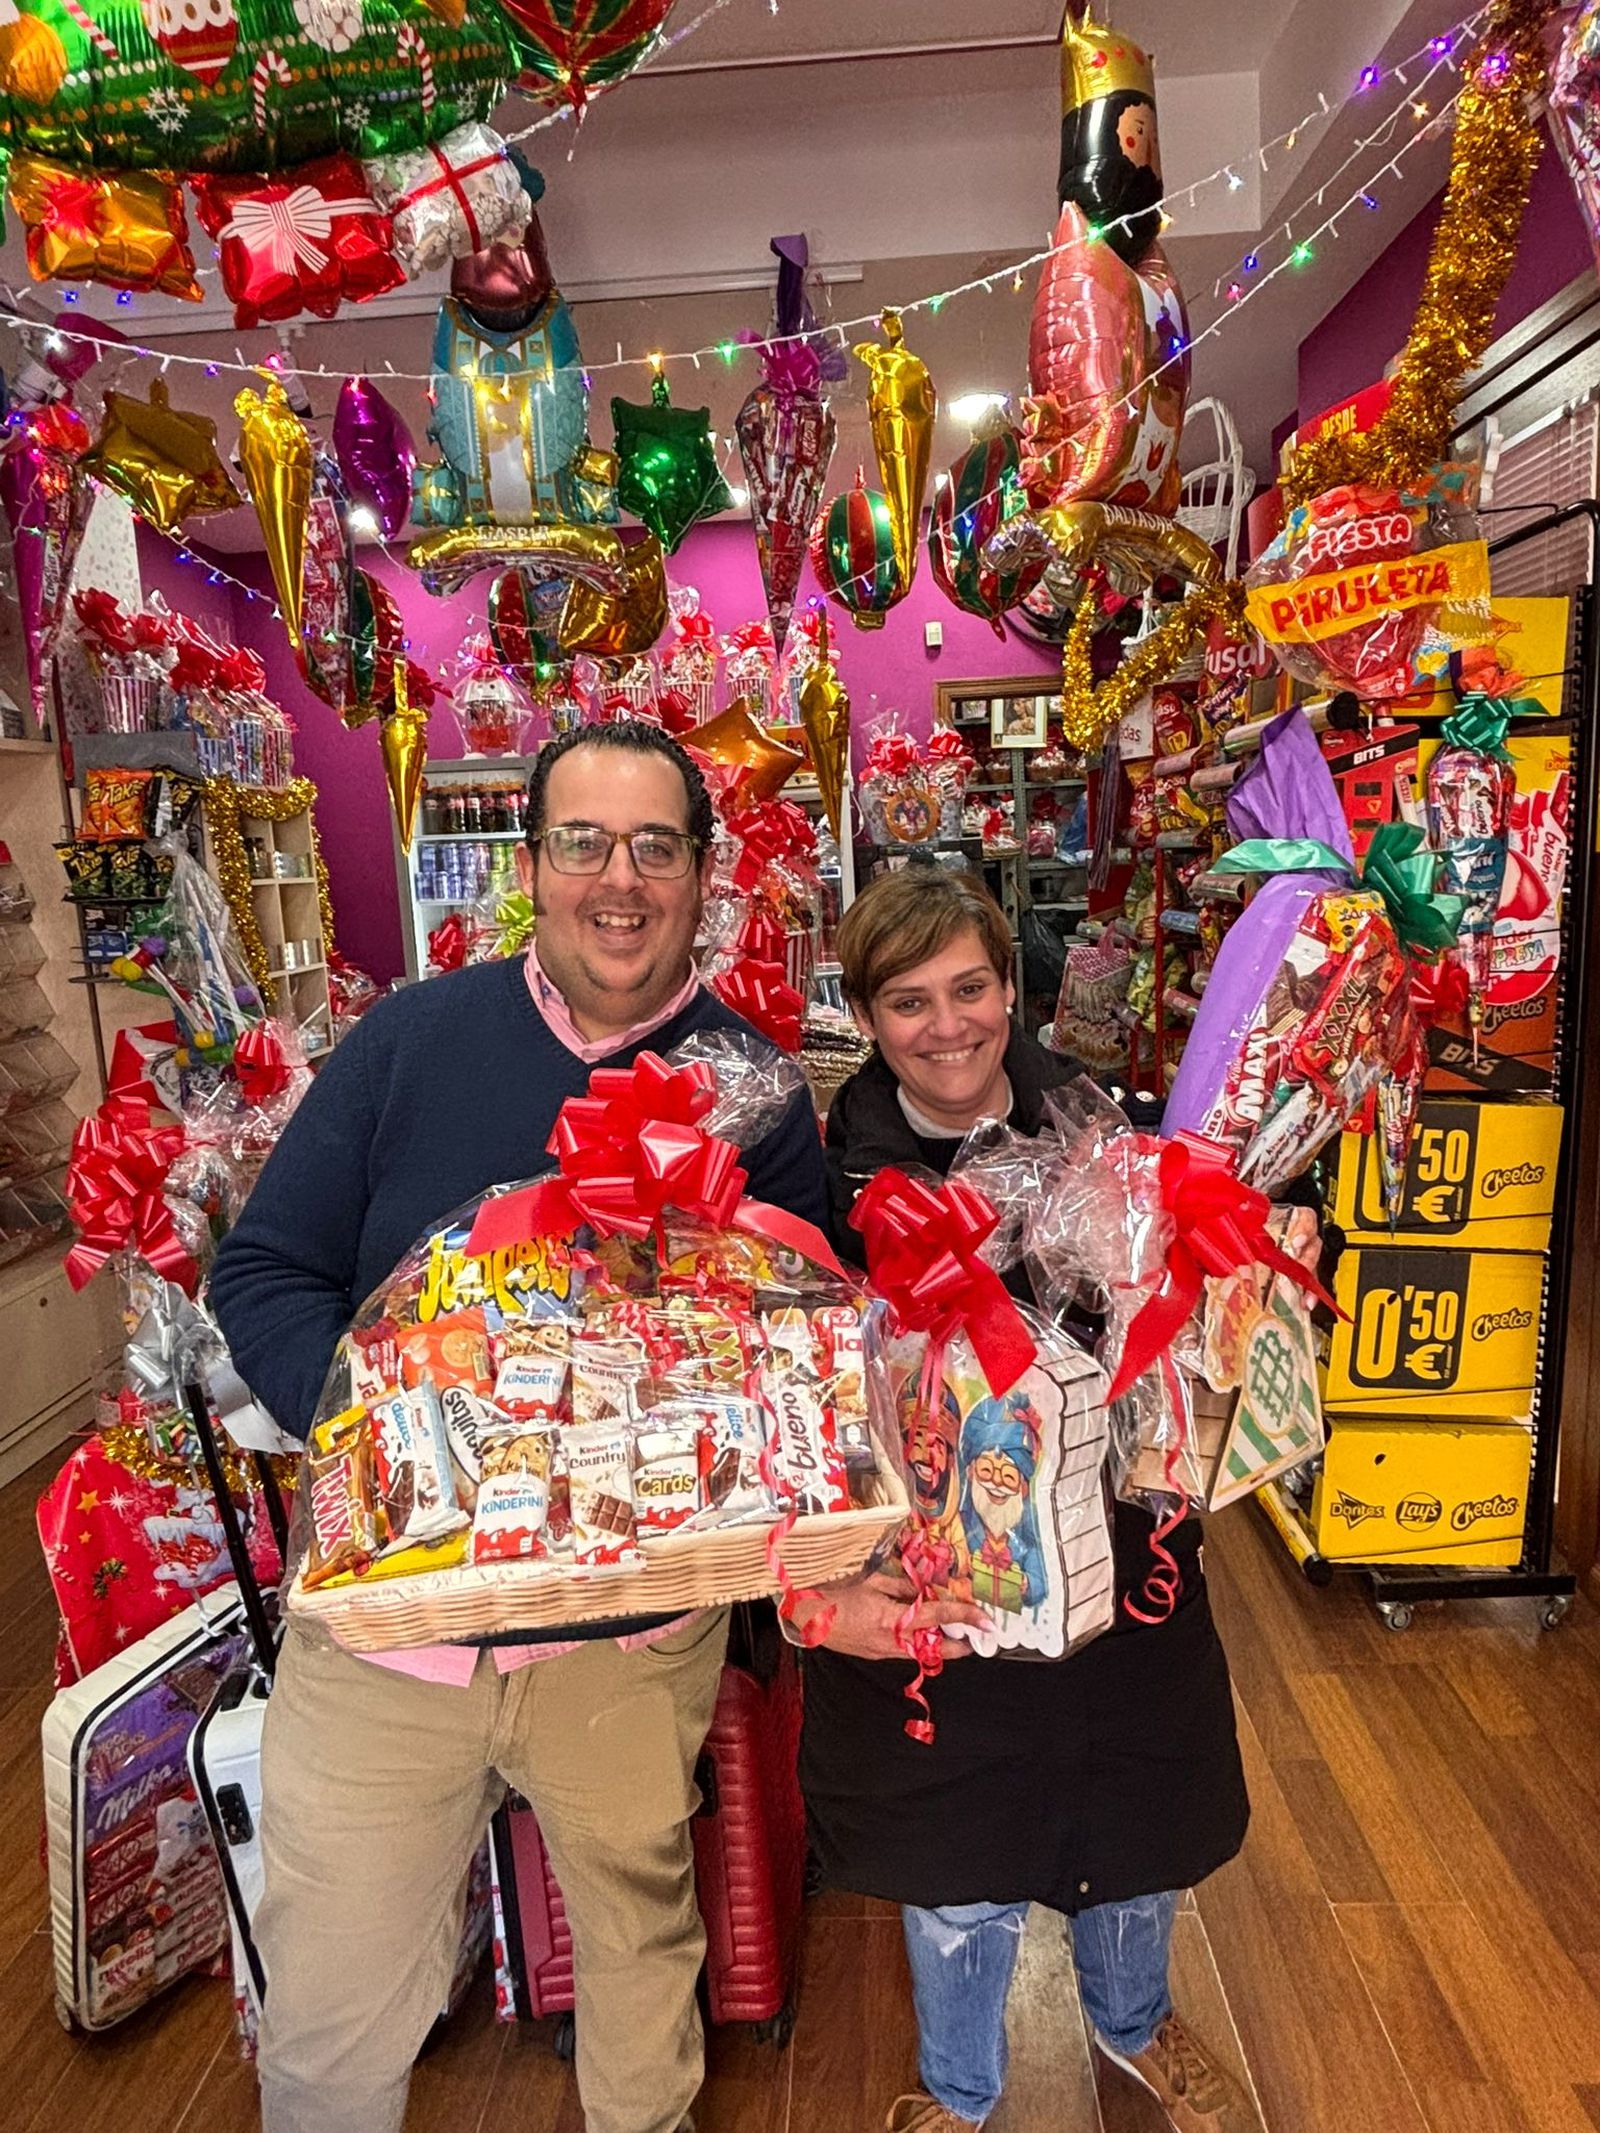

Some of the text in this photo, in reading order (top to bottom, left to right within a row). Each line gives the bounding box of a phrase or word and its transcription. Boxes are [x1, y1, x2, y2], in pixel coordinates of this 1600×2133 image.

[1307, 513, 1412, 563] FIESTA
[1353, 744, 1385, 765] BITS
[1234, 1032, 1268, 1121] MAXI
[1481, 1161, 1546, 1199] Cheetos
[1470, 1306, 1534, 1343] Cheetos
[781, 1390, 818, 1470] bueno
[569, 1451, 627, 1470] Country
[637, 1475, 696, 1496] Cards
[1450, 1493, 1520, 1532] Cheetos
[96, 1763, 174, 1831] Milka
